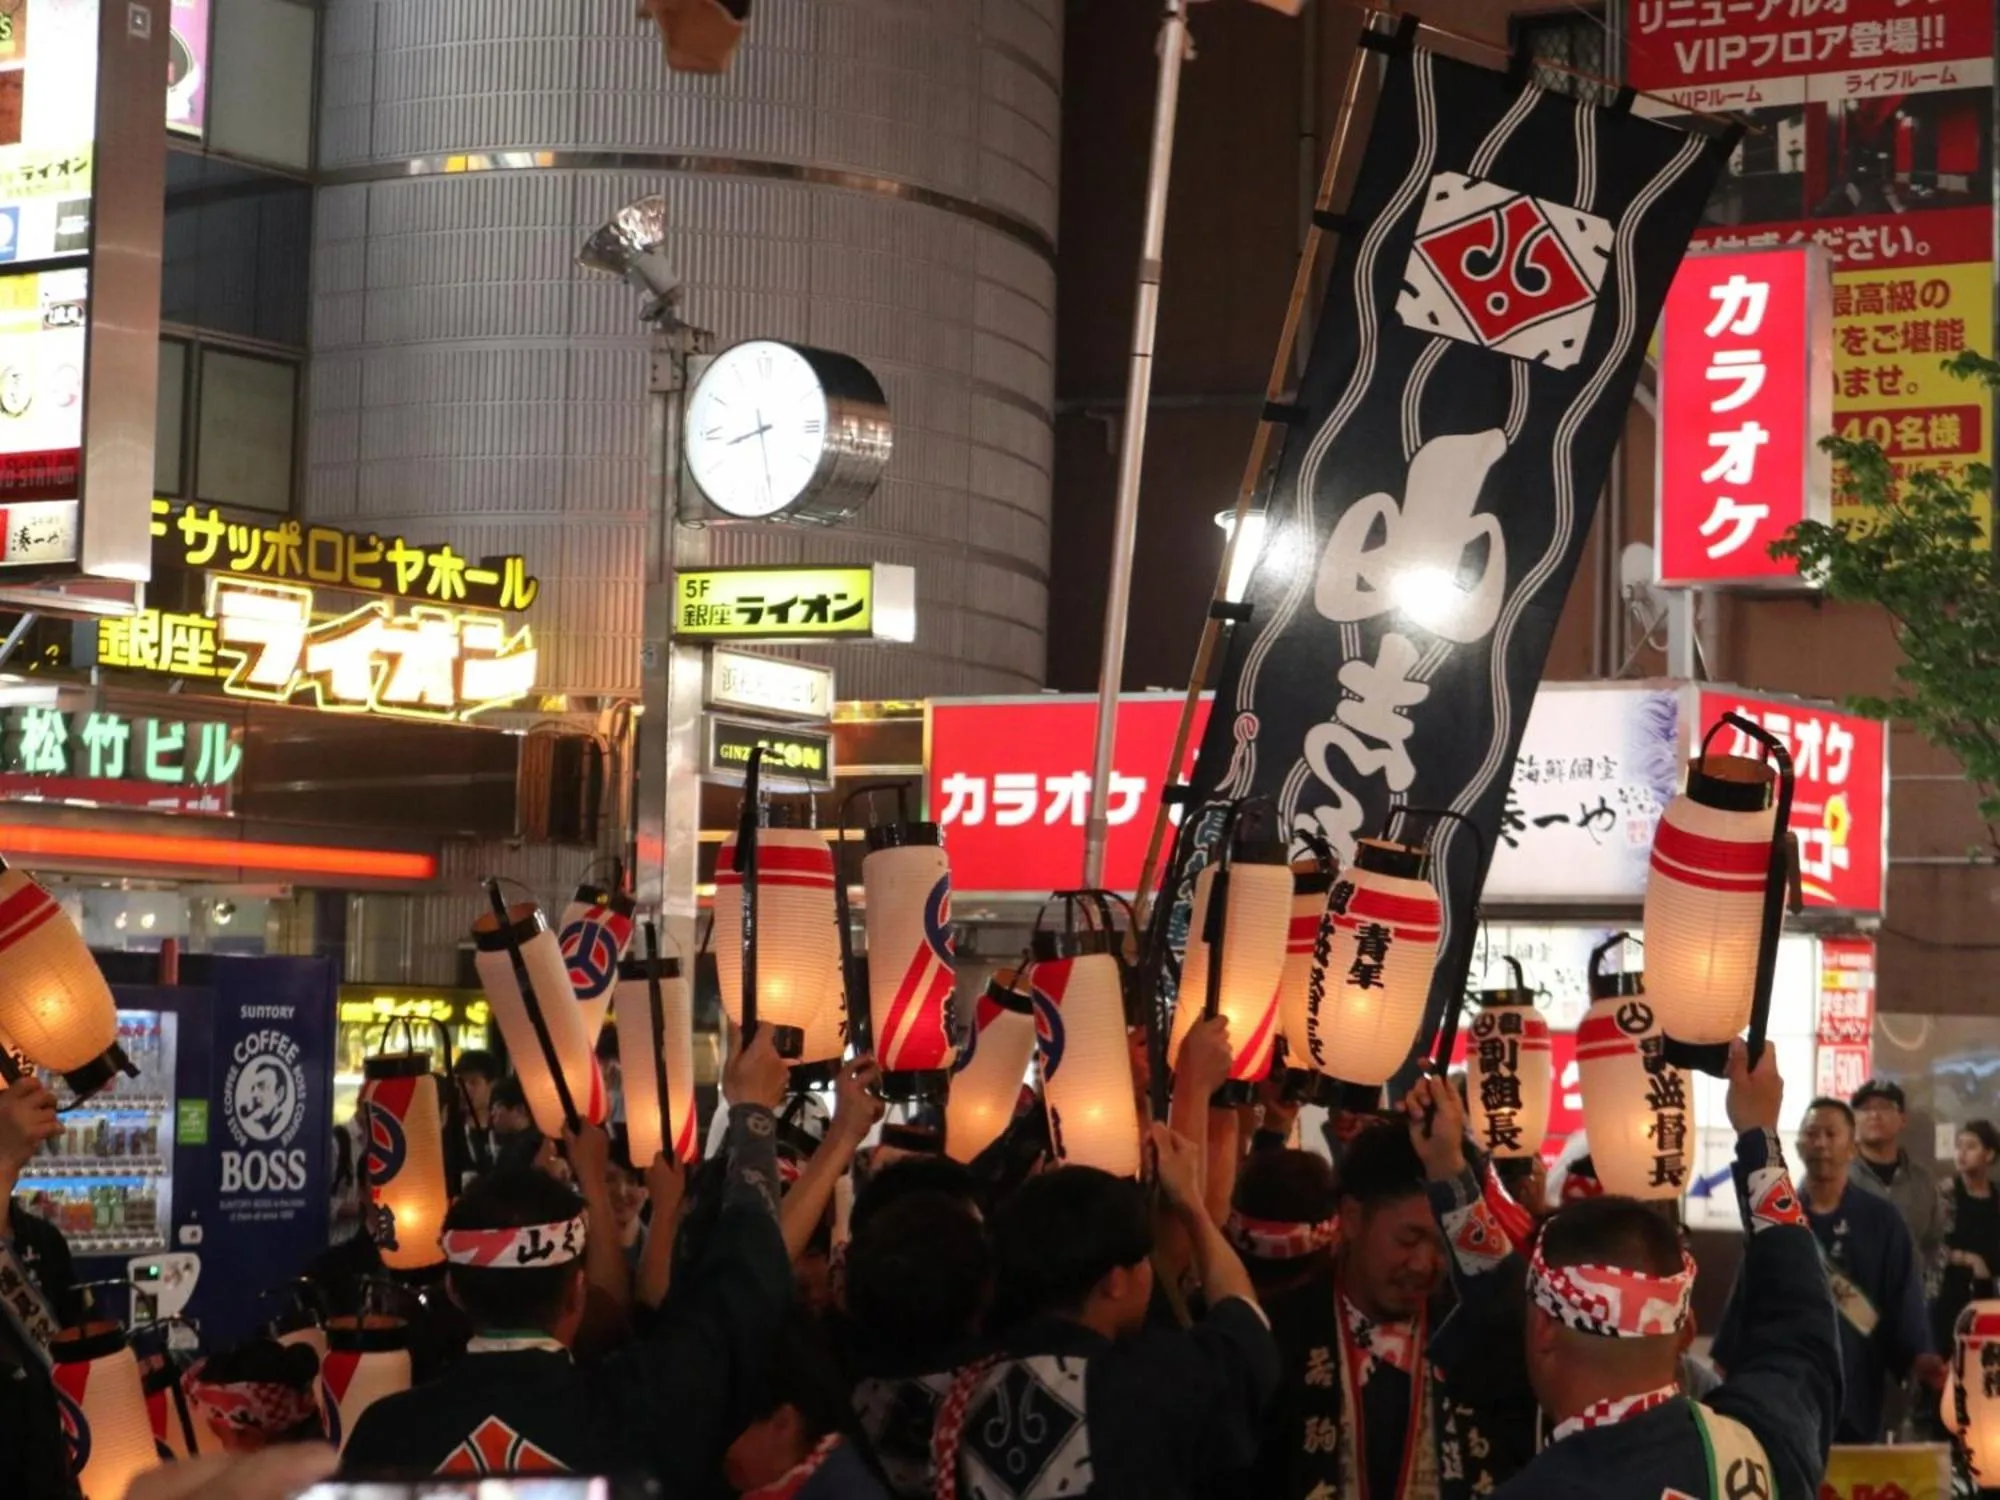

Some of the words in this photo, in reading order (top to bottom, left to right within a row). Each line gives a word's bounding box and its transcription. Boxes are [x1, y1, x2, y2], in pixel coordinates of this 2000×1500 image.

[1674, 14, 1945, 74] VIPフロア登場!!
[1845, 66, 1957, 93] ライブルーム
[1833, 318, 1965, 356] をご堪能
[1699, 274, 1770, 560] カラオケ
[178, 505, 538, 612] サッポロビヤホール
[685, 579, 710, 598] 5F
[20, 706, 242, 786] 松竹ビル
[720, 744, 757, 763] GINZ
[941, 771, 1147, 826] カラオケ
[1347, 922, 1393, 990] 青年
[240, 1004, 295, 1019] SUNTORY
[234, 1029, 299, 1064] COFFEE
[219, 1149, 307, 1193] BOSS
